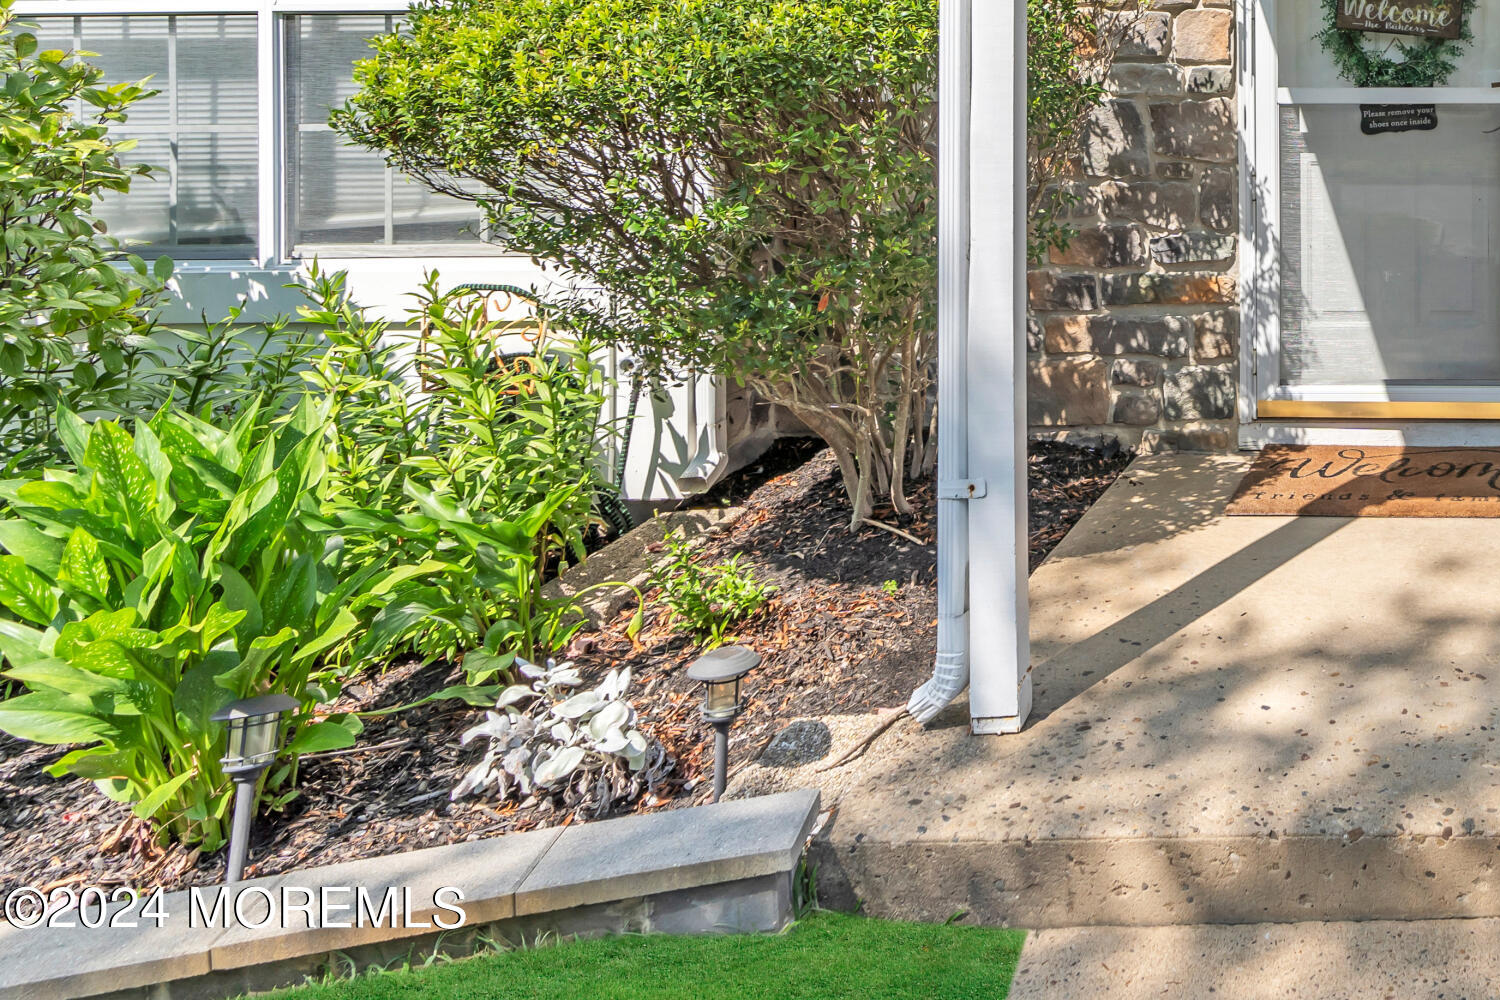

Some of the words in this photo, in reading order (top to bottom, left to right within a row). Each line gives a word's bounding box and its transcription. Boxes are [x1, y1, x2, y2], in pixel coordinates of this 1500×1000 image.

[1363, 110, 1386, 118] Please
[1387, 109, 1415, 117] remove
[1417, 107, 1434, 116] your
[1369, 120, 1389, 129] shoes
[1409, 117, 1432, 126] inside
[1253, 491, 1370, 500] friends
[1386, 489, 1415, 501] &
